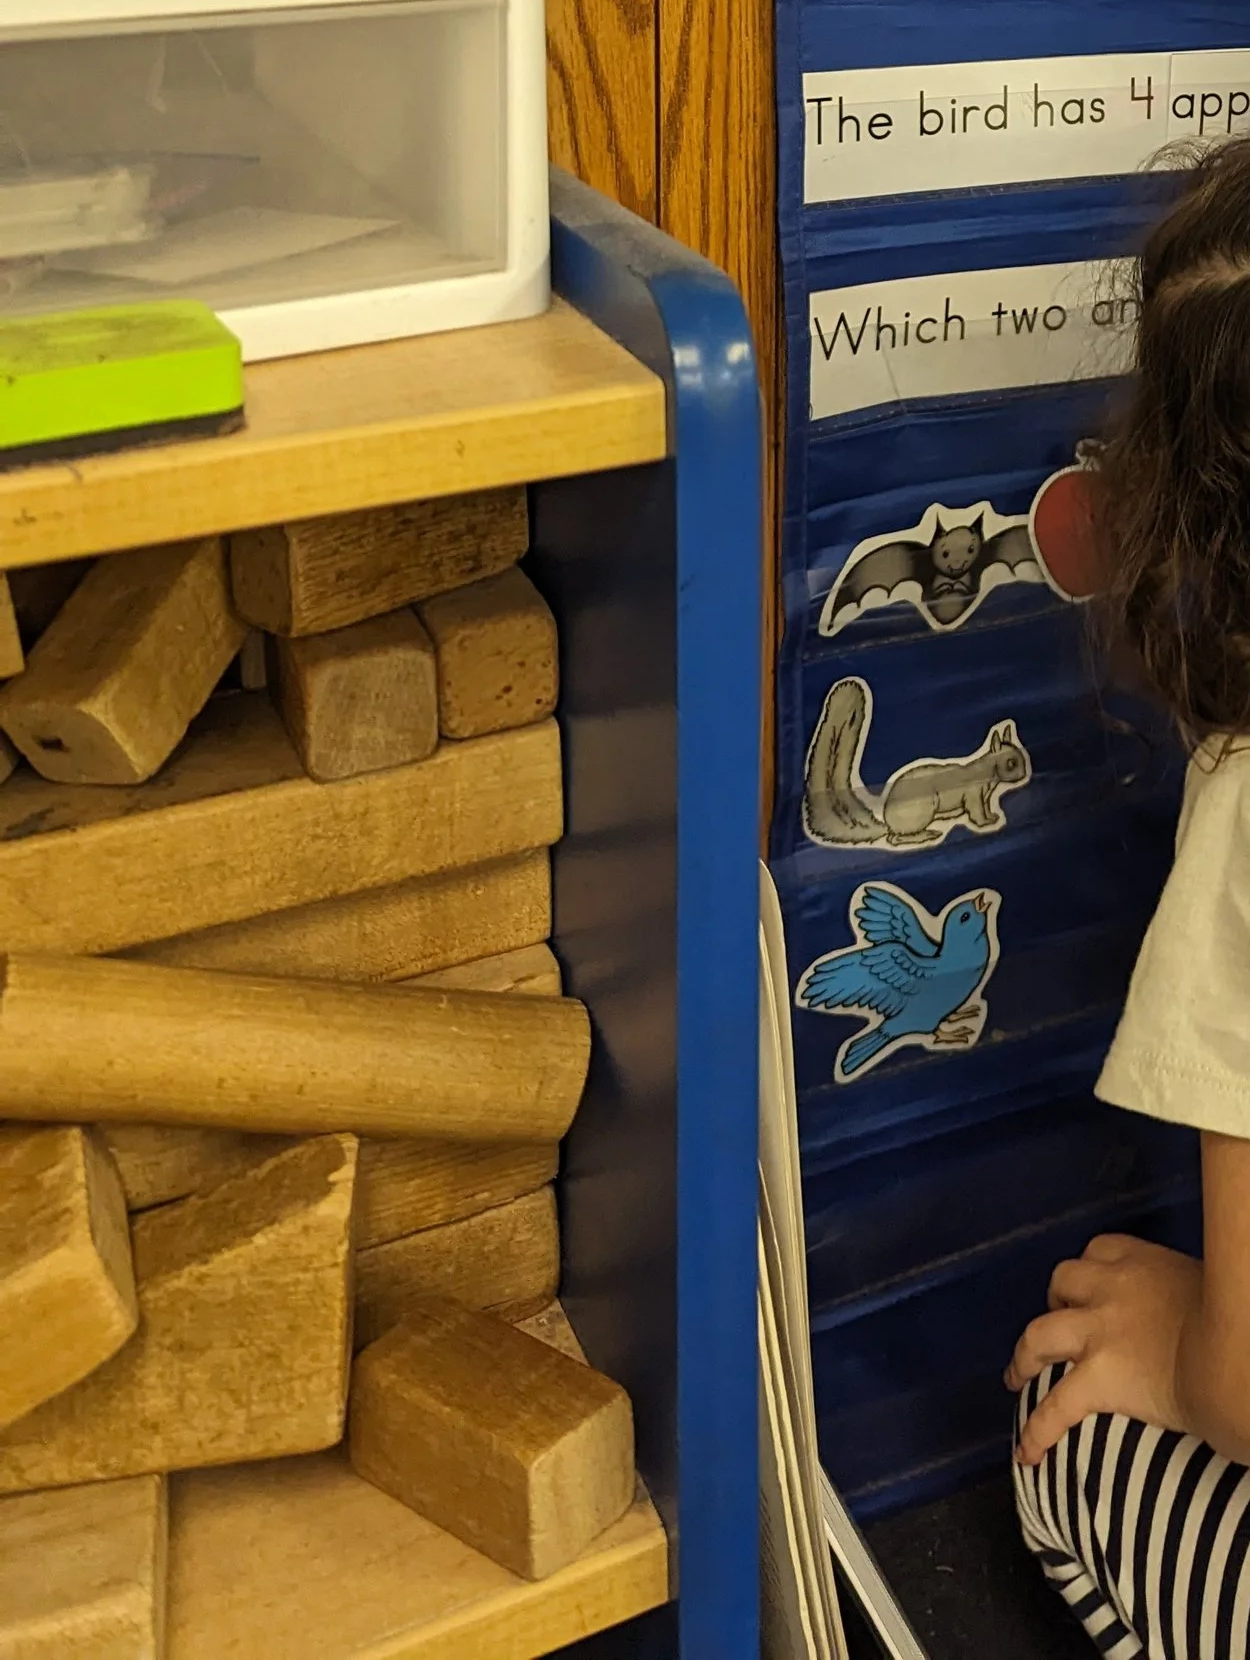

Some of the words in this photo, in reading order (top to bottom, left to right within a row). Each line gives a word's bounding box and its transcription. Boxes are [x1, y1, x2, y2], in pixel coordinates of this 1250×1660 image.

[806, 96, 893, 145] The
[919, 84, 1008, 137] bird
[1033, 82, 1105, 128] has
[1130, 76, 1154, 120] 4
[813, 296, 965, 361] Which
[991, 301, 1067, 336] two
